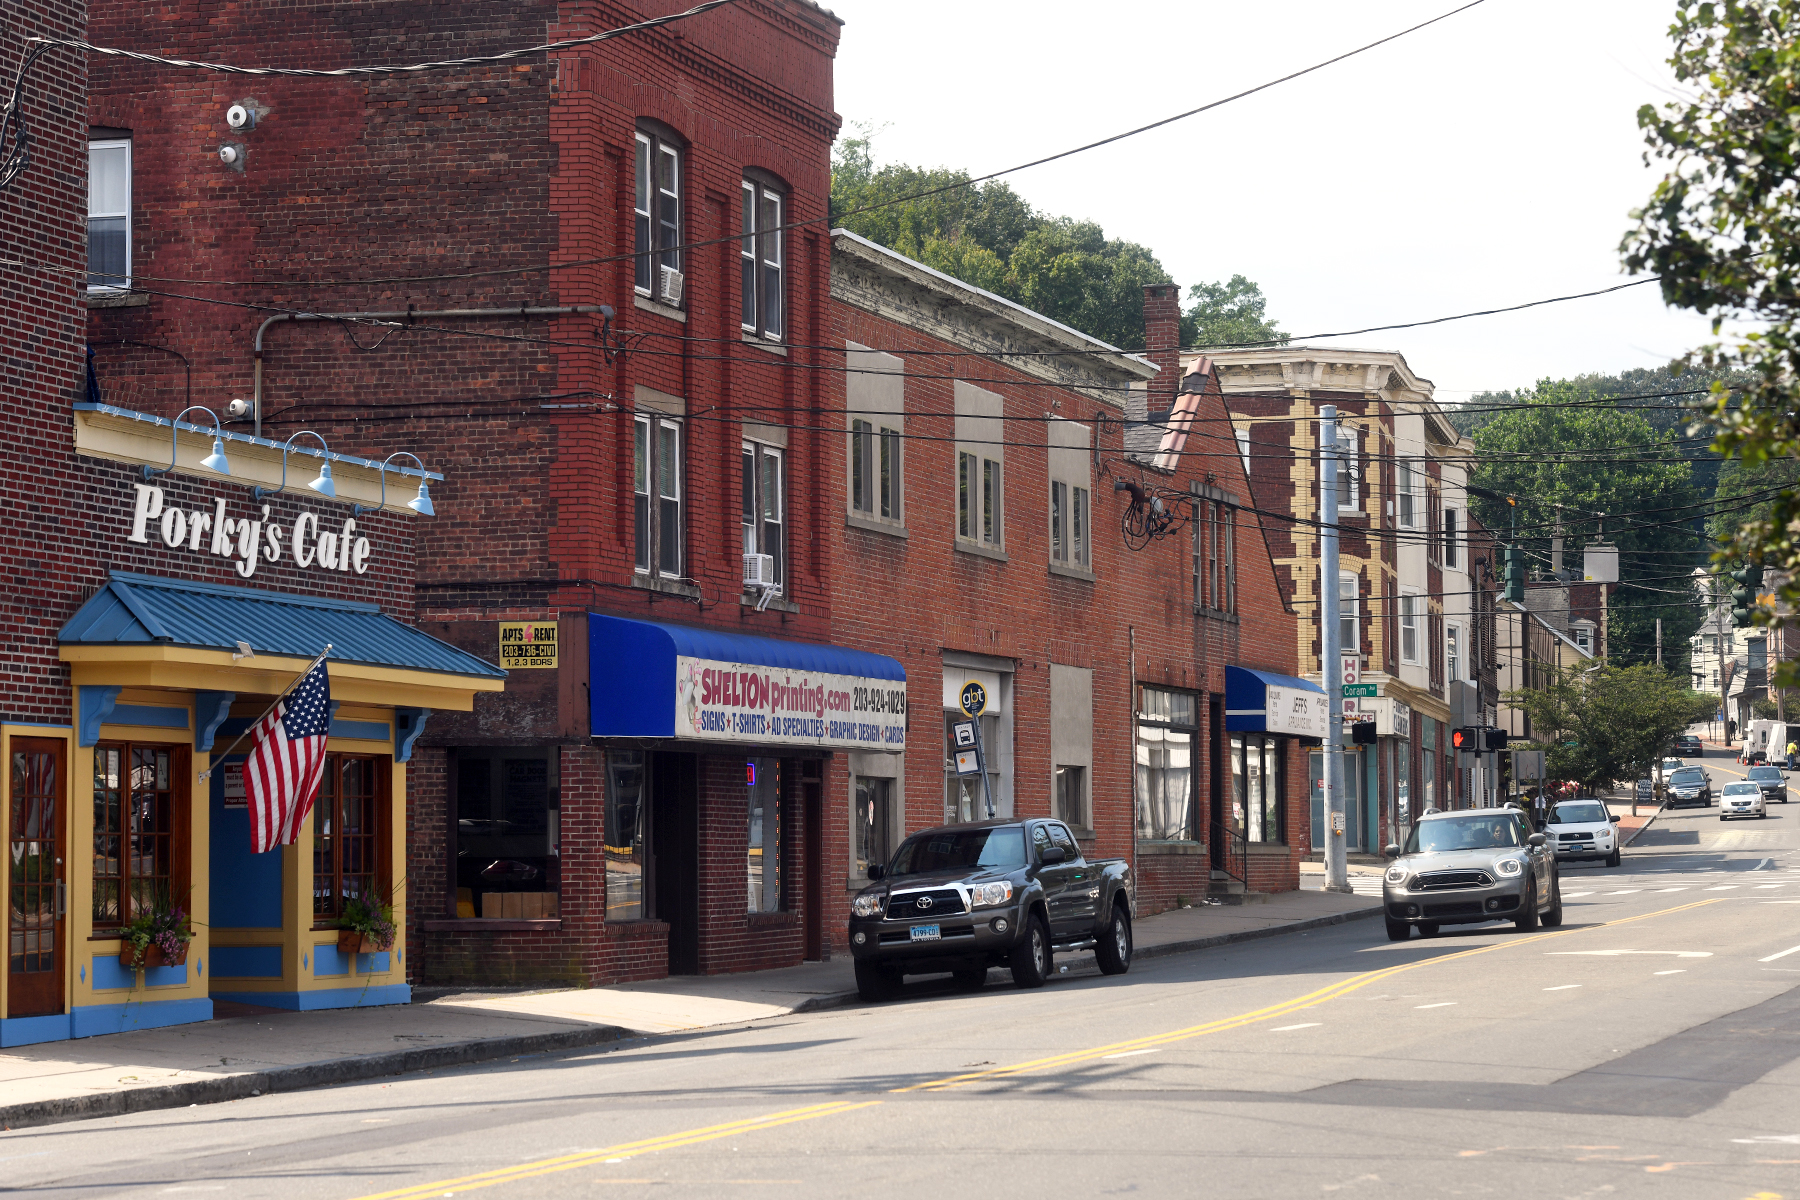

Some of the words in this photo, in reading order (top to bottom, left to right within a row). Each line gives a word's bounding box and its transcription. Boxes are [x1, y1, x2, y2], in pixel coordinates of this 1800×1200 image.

[127, 483, 283, 578] Porky's
[292, 512, 370, 575] Cafe
[502, 627, 524, 641] APTS
[524, 624, 534, 643] 4
[534, 627, 556, 641] RENT
[504, 645, 555, 657] 203-736-CIVI
[701, 667, 770, 710] SHELTON
[771, 676, 851, 719] printing.com
[853, 686, 905, 715] 203-924-1029
[1344, 659, 1356, 712] HOR
[1344, 686, 1367, 696] Coram
[962, 688, 984, 708] gbt
[1292, 696, 1308, 715] JEFFS
[701, 709, 726, 732] SIGNS
[732, 712, 766, 735] T-SHIRTS
[771, 716, 781, 736] AD
[782, 716, 824, 738] SPECIALTIES
[829, 720, 857, 741] GRAPHIC
[858, 722, 880, 743] DESIGN
[884, 725, 904, 744] CARDS
